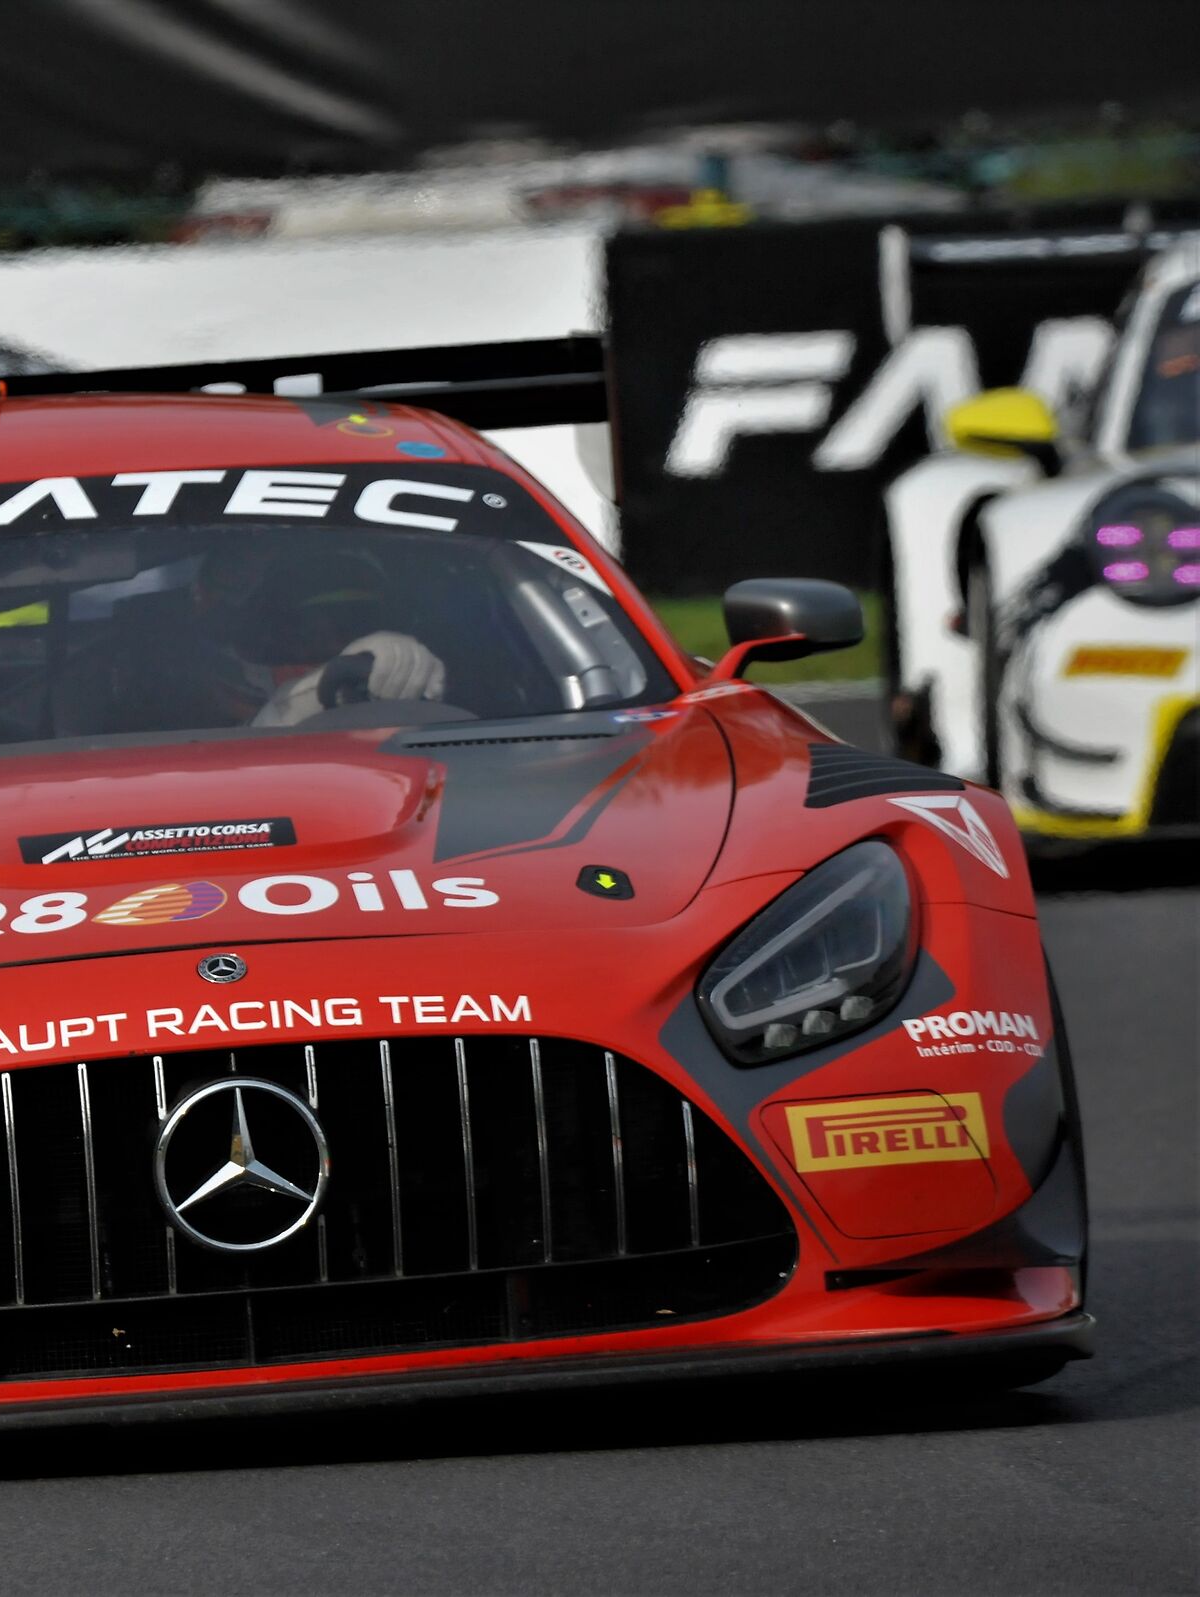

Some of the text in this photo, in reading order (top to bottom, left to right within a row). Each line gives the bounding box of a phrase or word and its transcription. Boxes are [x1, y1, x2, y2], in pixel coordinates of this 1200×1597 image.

[124, 832, 270, 852] COMPETIZIONE
[130, 822, 271, 842] ASSETTO CORSA
[91, 851, 135, 860] OFFICIAL
[151, 847, 185, 855] WORLD
[187, 844, 245, 852] CHALLENGE
[237, 868, 500, 916] Oils
[145, 995, 363, 1039] RACING
[378, 994, 533, 1025] TEAM
[901, 1010, 1040, 1042] PROMAN
[916, 1041, 977, 1058] Intérim
[804, 1104, 970, 1159] PIRELLI
